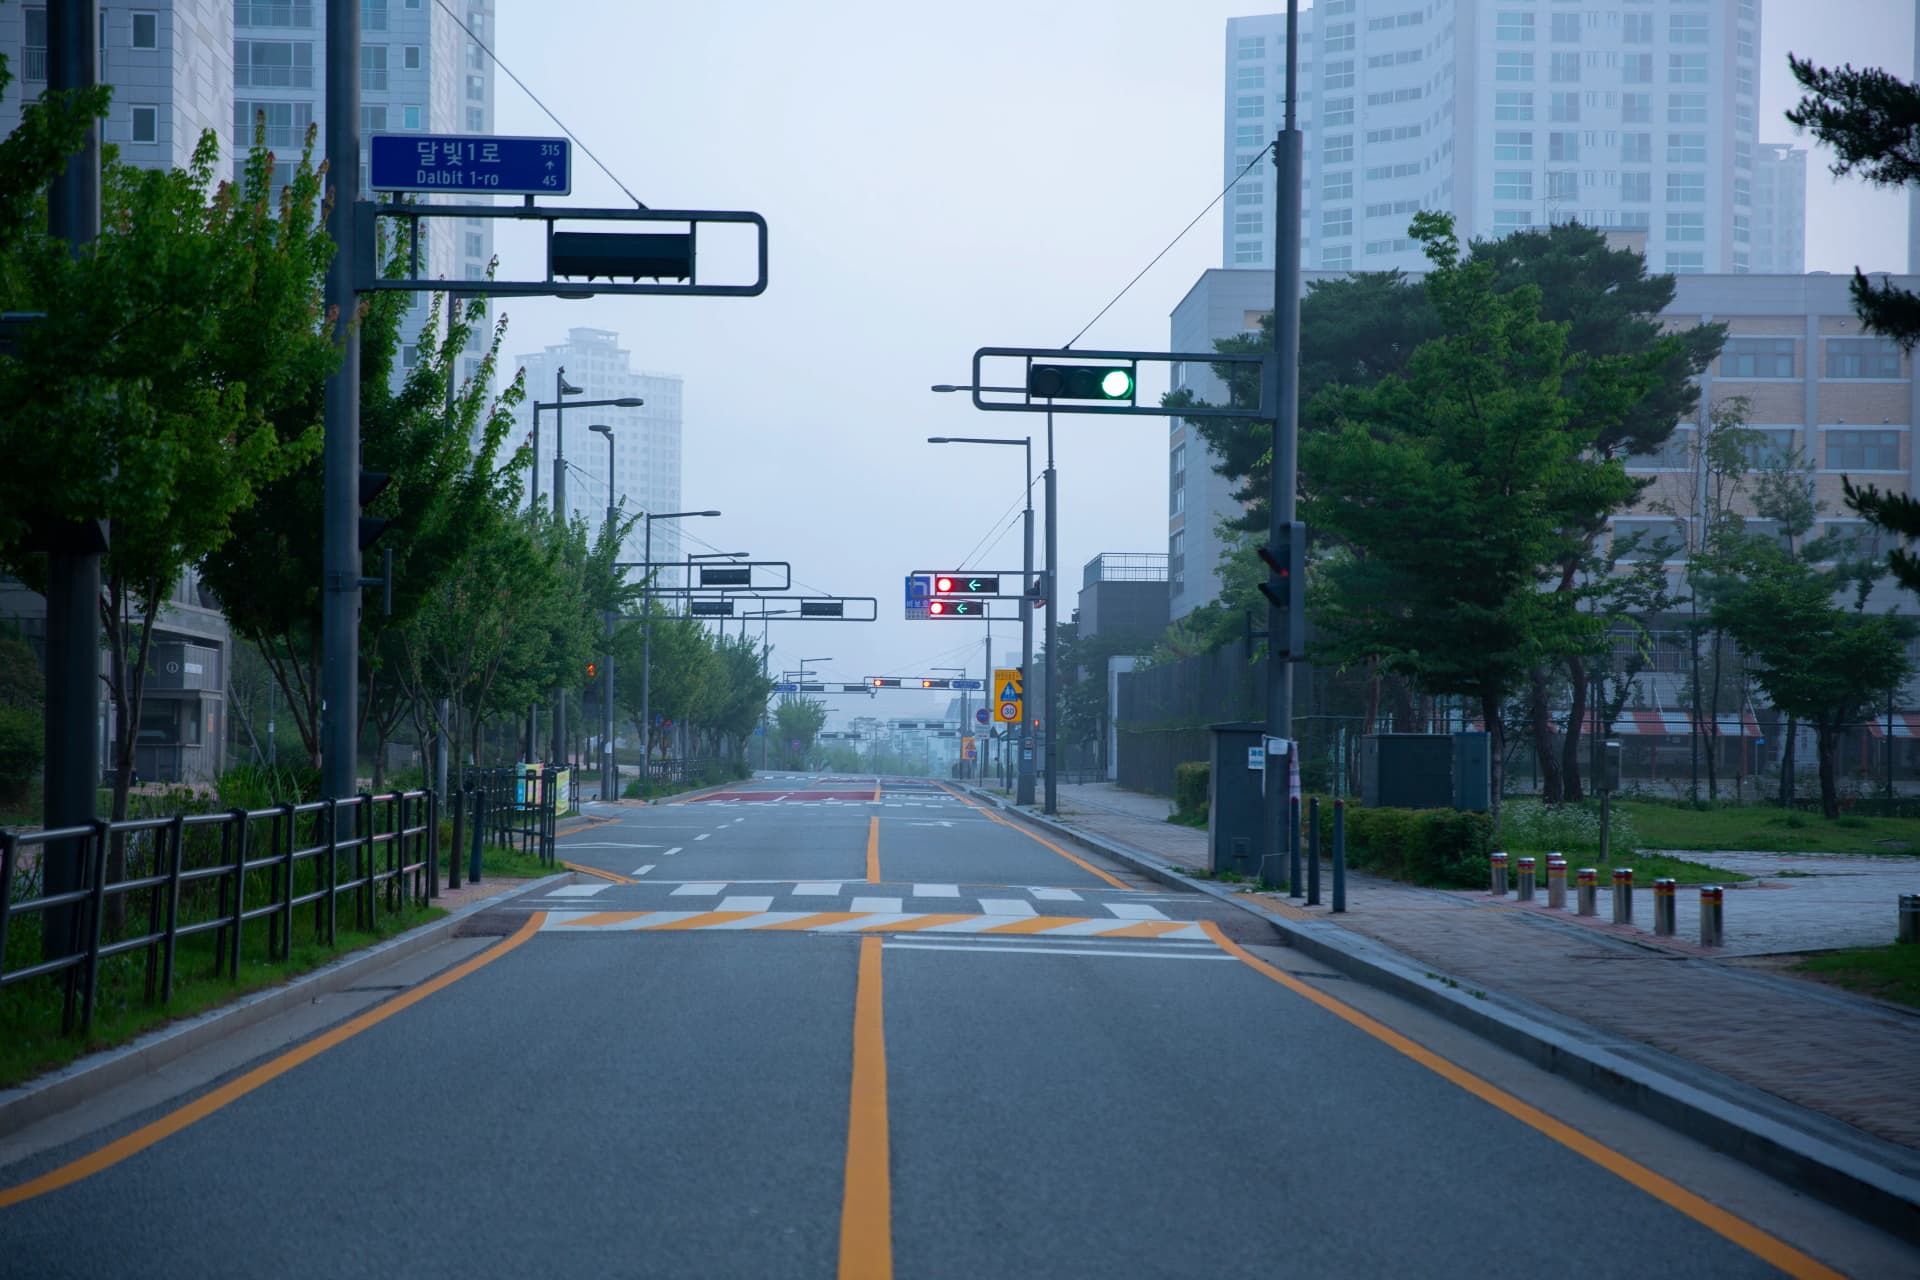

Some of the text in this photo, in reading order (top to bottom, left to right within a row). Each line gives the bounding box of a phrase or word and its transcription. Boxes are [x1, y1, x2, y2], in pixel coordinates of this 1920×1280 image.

[417, 141, 501, 167] 달빛1로
[540, 144, 560, 156] 315
[416, 169, 499, 186] Dalbit 1-ro
[542, 175, 557, 186] 45
[1004, 707, 1014, 715] 30
